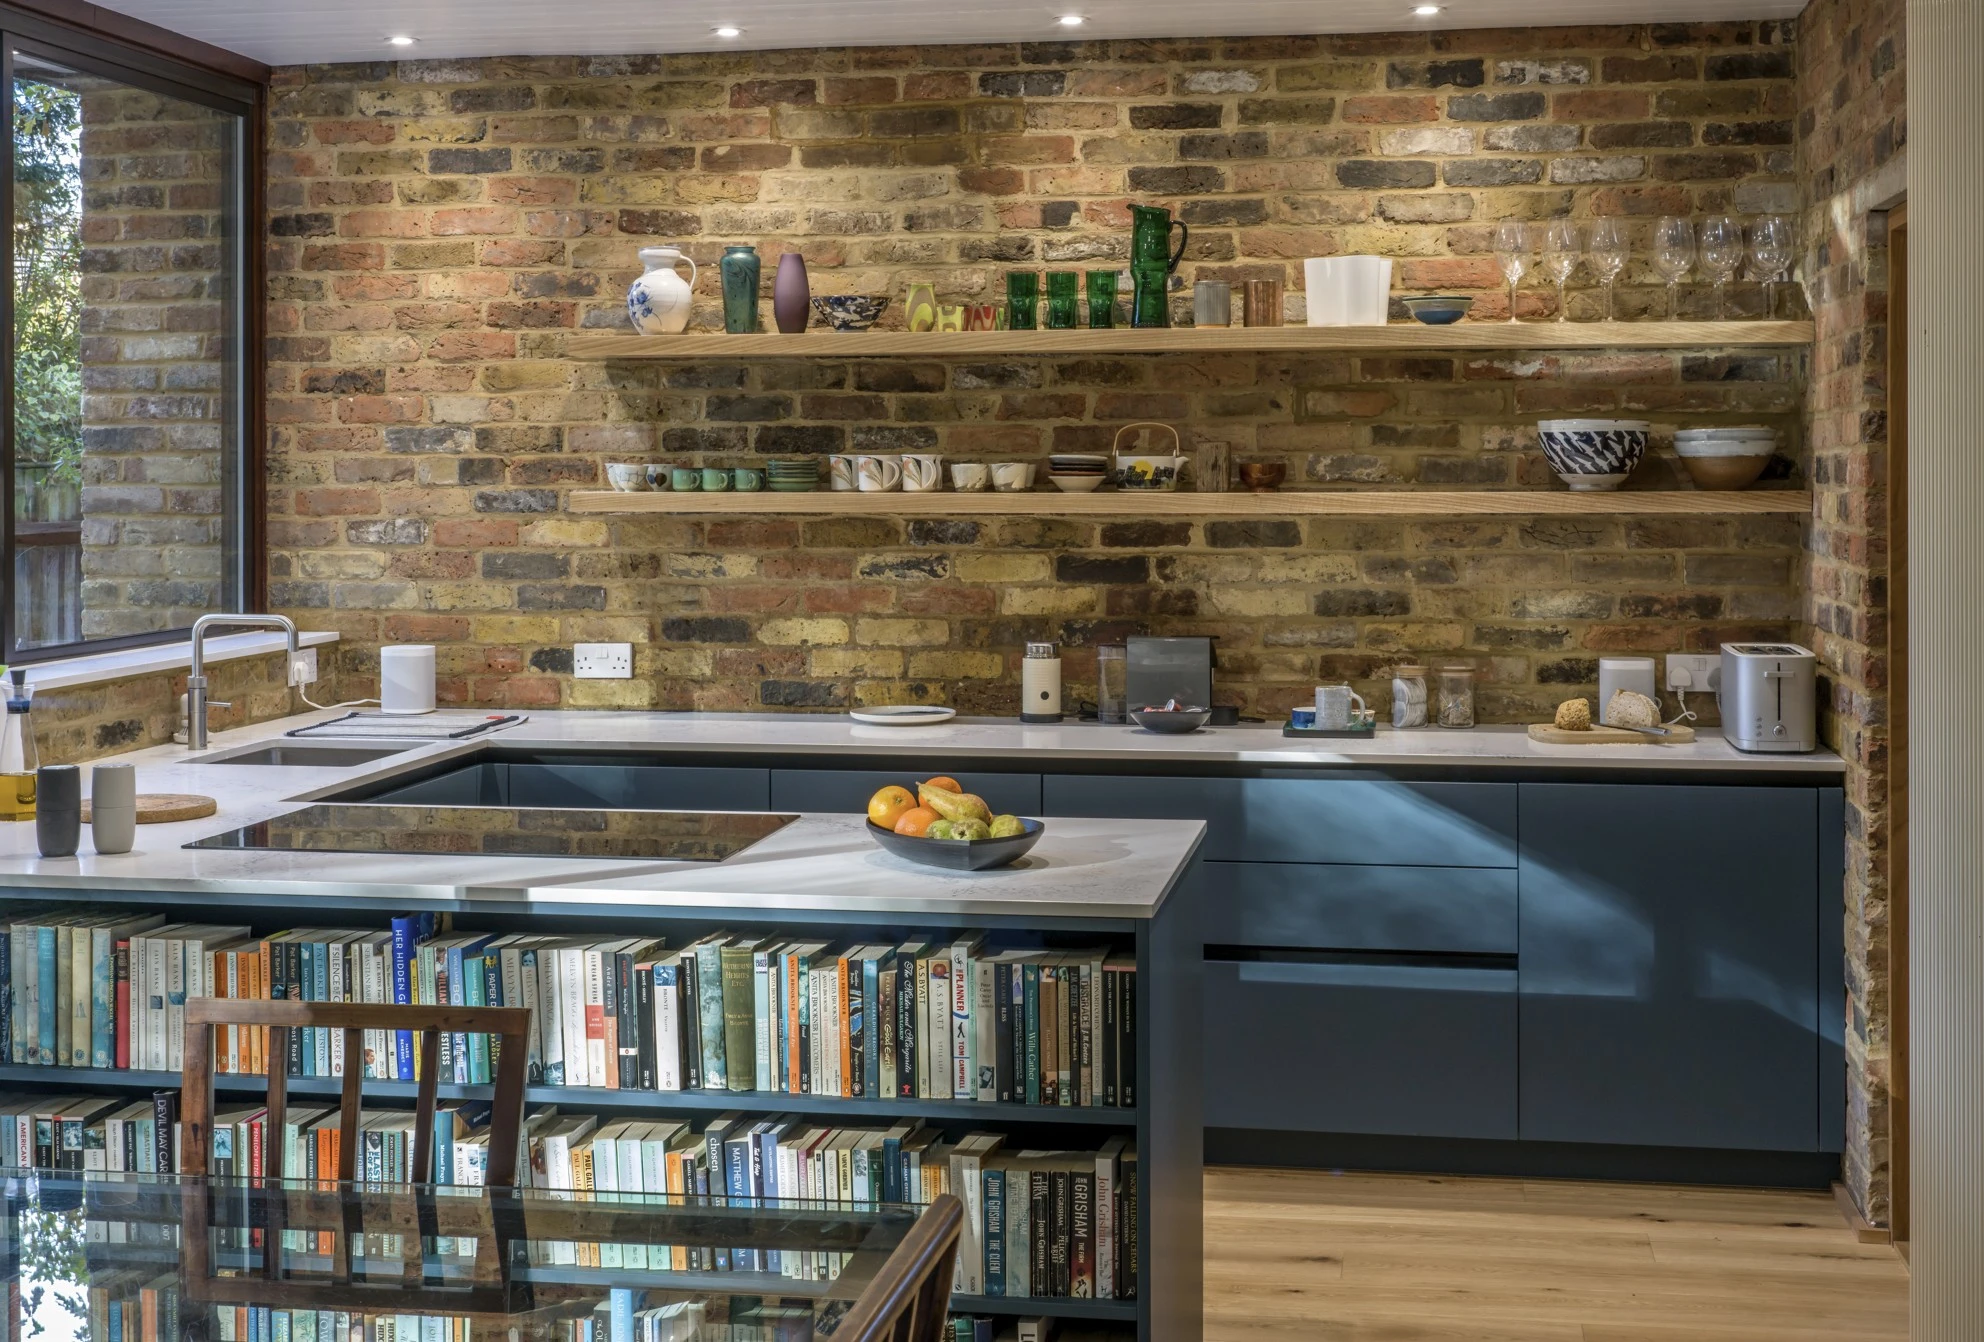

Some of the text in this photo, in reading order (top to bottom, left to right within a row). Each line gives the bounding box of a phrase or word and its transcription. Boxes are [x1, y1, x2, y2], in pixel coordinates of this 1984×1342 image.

[395, 930, 403, 948] HER
[332, 952, 341, 985] SILENCE
[507, 957, 516, 994] MELVYN
[544, 956, 552, 993] MELVYN
[569, 957, 577, 989] MELVYN
[439, 972, 447, 1003] WILLIAM
[956, 974, 964, 1011] PLANNER
[1081, 980, 1089, 1025] DISGRACE
[546, 996, 554, 1025] BRAGG
[902, 961, 913, 1073] The Master and Margarita
[884, 1024, 892, 1045] Good
[812, 1032, 820, 1075] LATECOMERS
[1028, 1032, 1036, 1080] Willa Cather
[157, 1100, 167, 1149] DEVIL MAY
[143, 1126, 151, 1162] SEBASTIAN
[710, 1137, 719, 1172] chosen
[732, 1147, 742, 1189] MATTHEW
[1010, 1184, 1018, 1202] TIME
[1032, 1176, 1042, 1200] FIRM
[988, 1178, 1001, 1275] JOHN GRISHAM THE CLIENT
[1074, 1184, 1088, 1238] GRISHAM
[1097, 1176, 1110, 1247] John Grisham
[1037, 1220, 1046, 1269] JOHN GRISHAM
[1131, 1230, 1137, 1241] ON
